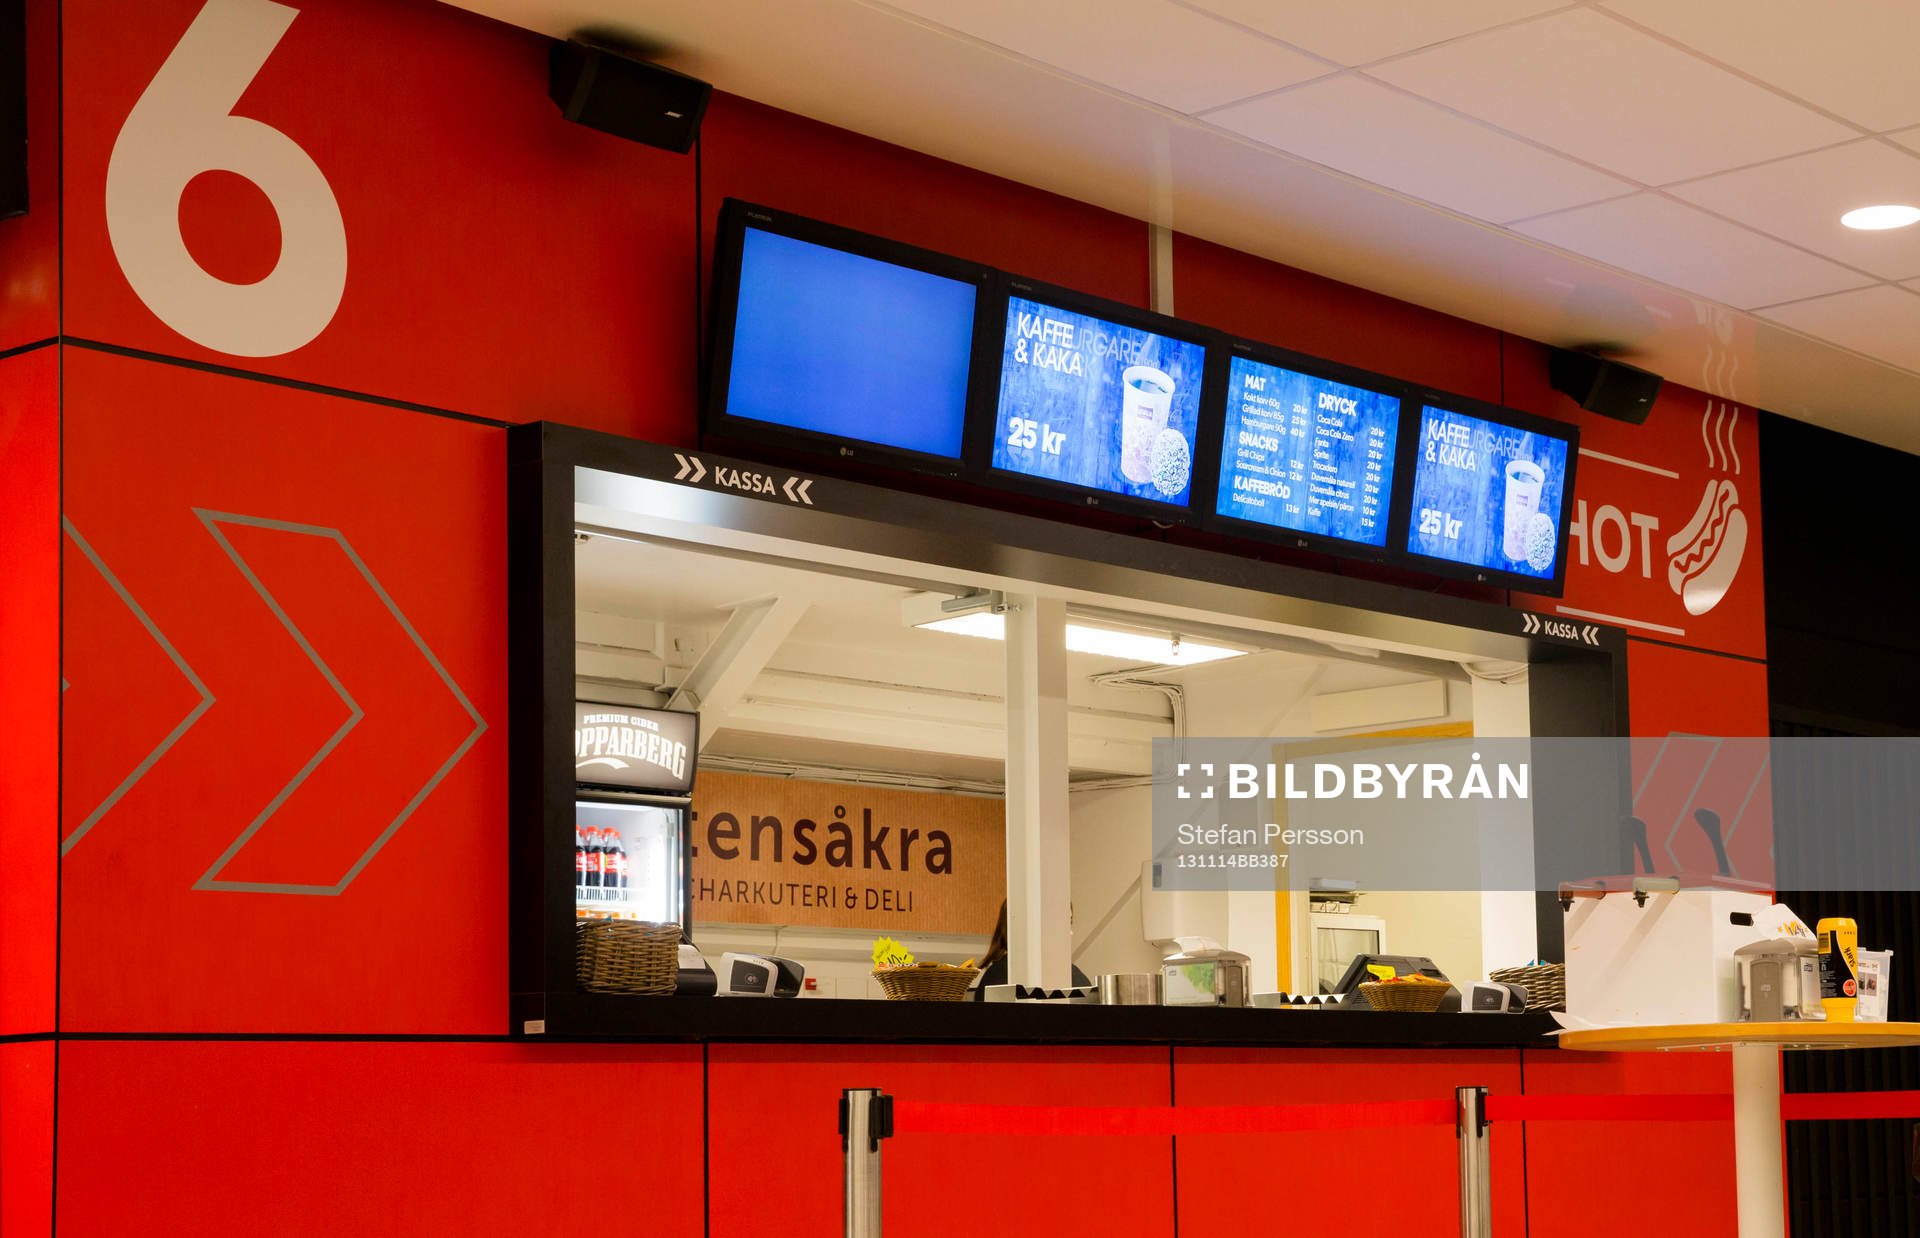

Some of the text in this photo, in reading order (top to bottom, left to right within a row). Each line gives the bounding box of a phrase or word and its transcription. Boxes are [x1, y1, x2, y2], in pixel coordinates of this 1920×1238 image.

[105, 0, 349, 359] 6
[1016, 311, 1074, 349] KAFFE
[1014, 338, 1029, 364] &
[1032, 342, 1083, 377] KAKA
[1245, 374, 1267, 391] MAT
[1319, 392, 1358, 417] DRYCK
[1317, 427, 1330, 436] Coca
[1330, 429, 1342, 439] Cola
[1318, 415, 1331, 425] Coca
[1331, 418, 1343, 428] Cola
[1427, 417, 1471, 448] KAFFE
[1007, 416, 1067, 456] 25 kr
[1239, 431, 1279, 452] SNACKS
[1425, 440, 1436, 463] &
[1439, 444, 1477, 472] KAKA
[714, 466, 777, 496] KASSA
[1234, 476, 1291, 499] KAFFEBRÖD
[1419, 508, 1463, 540] 25 kr
[1569, 499, 1659, 579] HOT
[1544, 620, 1579, 641] KASSA
[583, 713, 659, 732] PREMIUM CIDER
[844, 886, 858, 909] &
[865, 887, 913, 912] DELI
